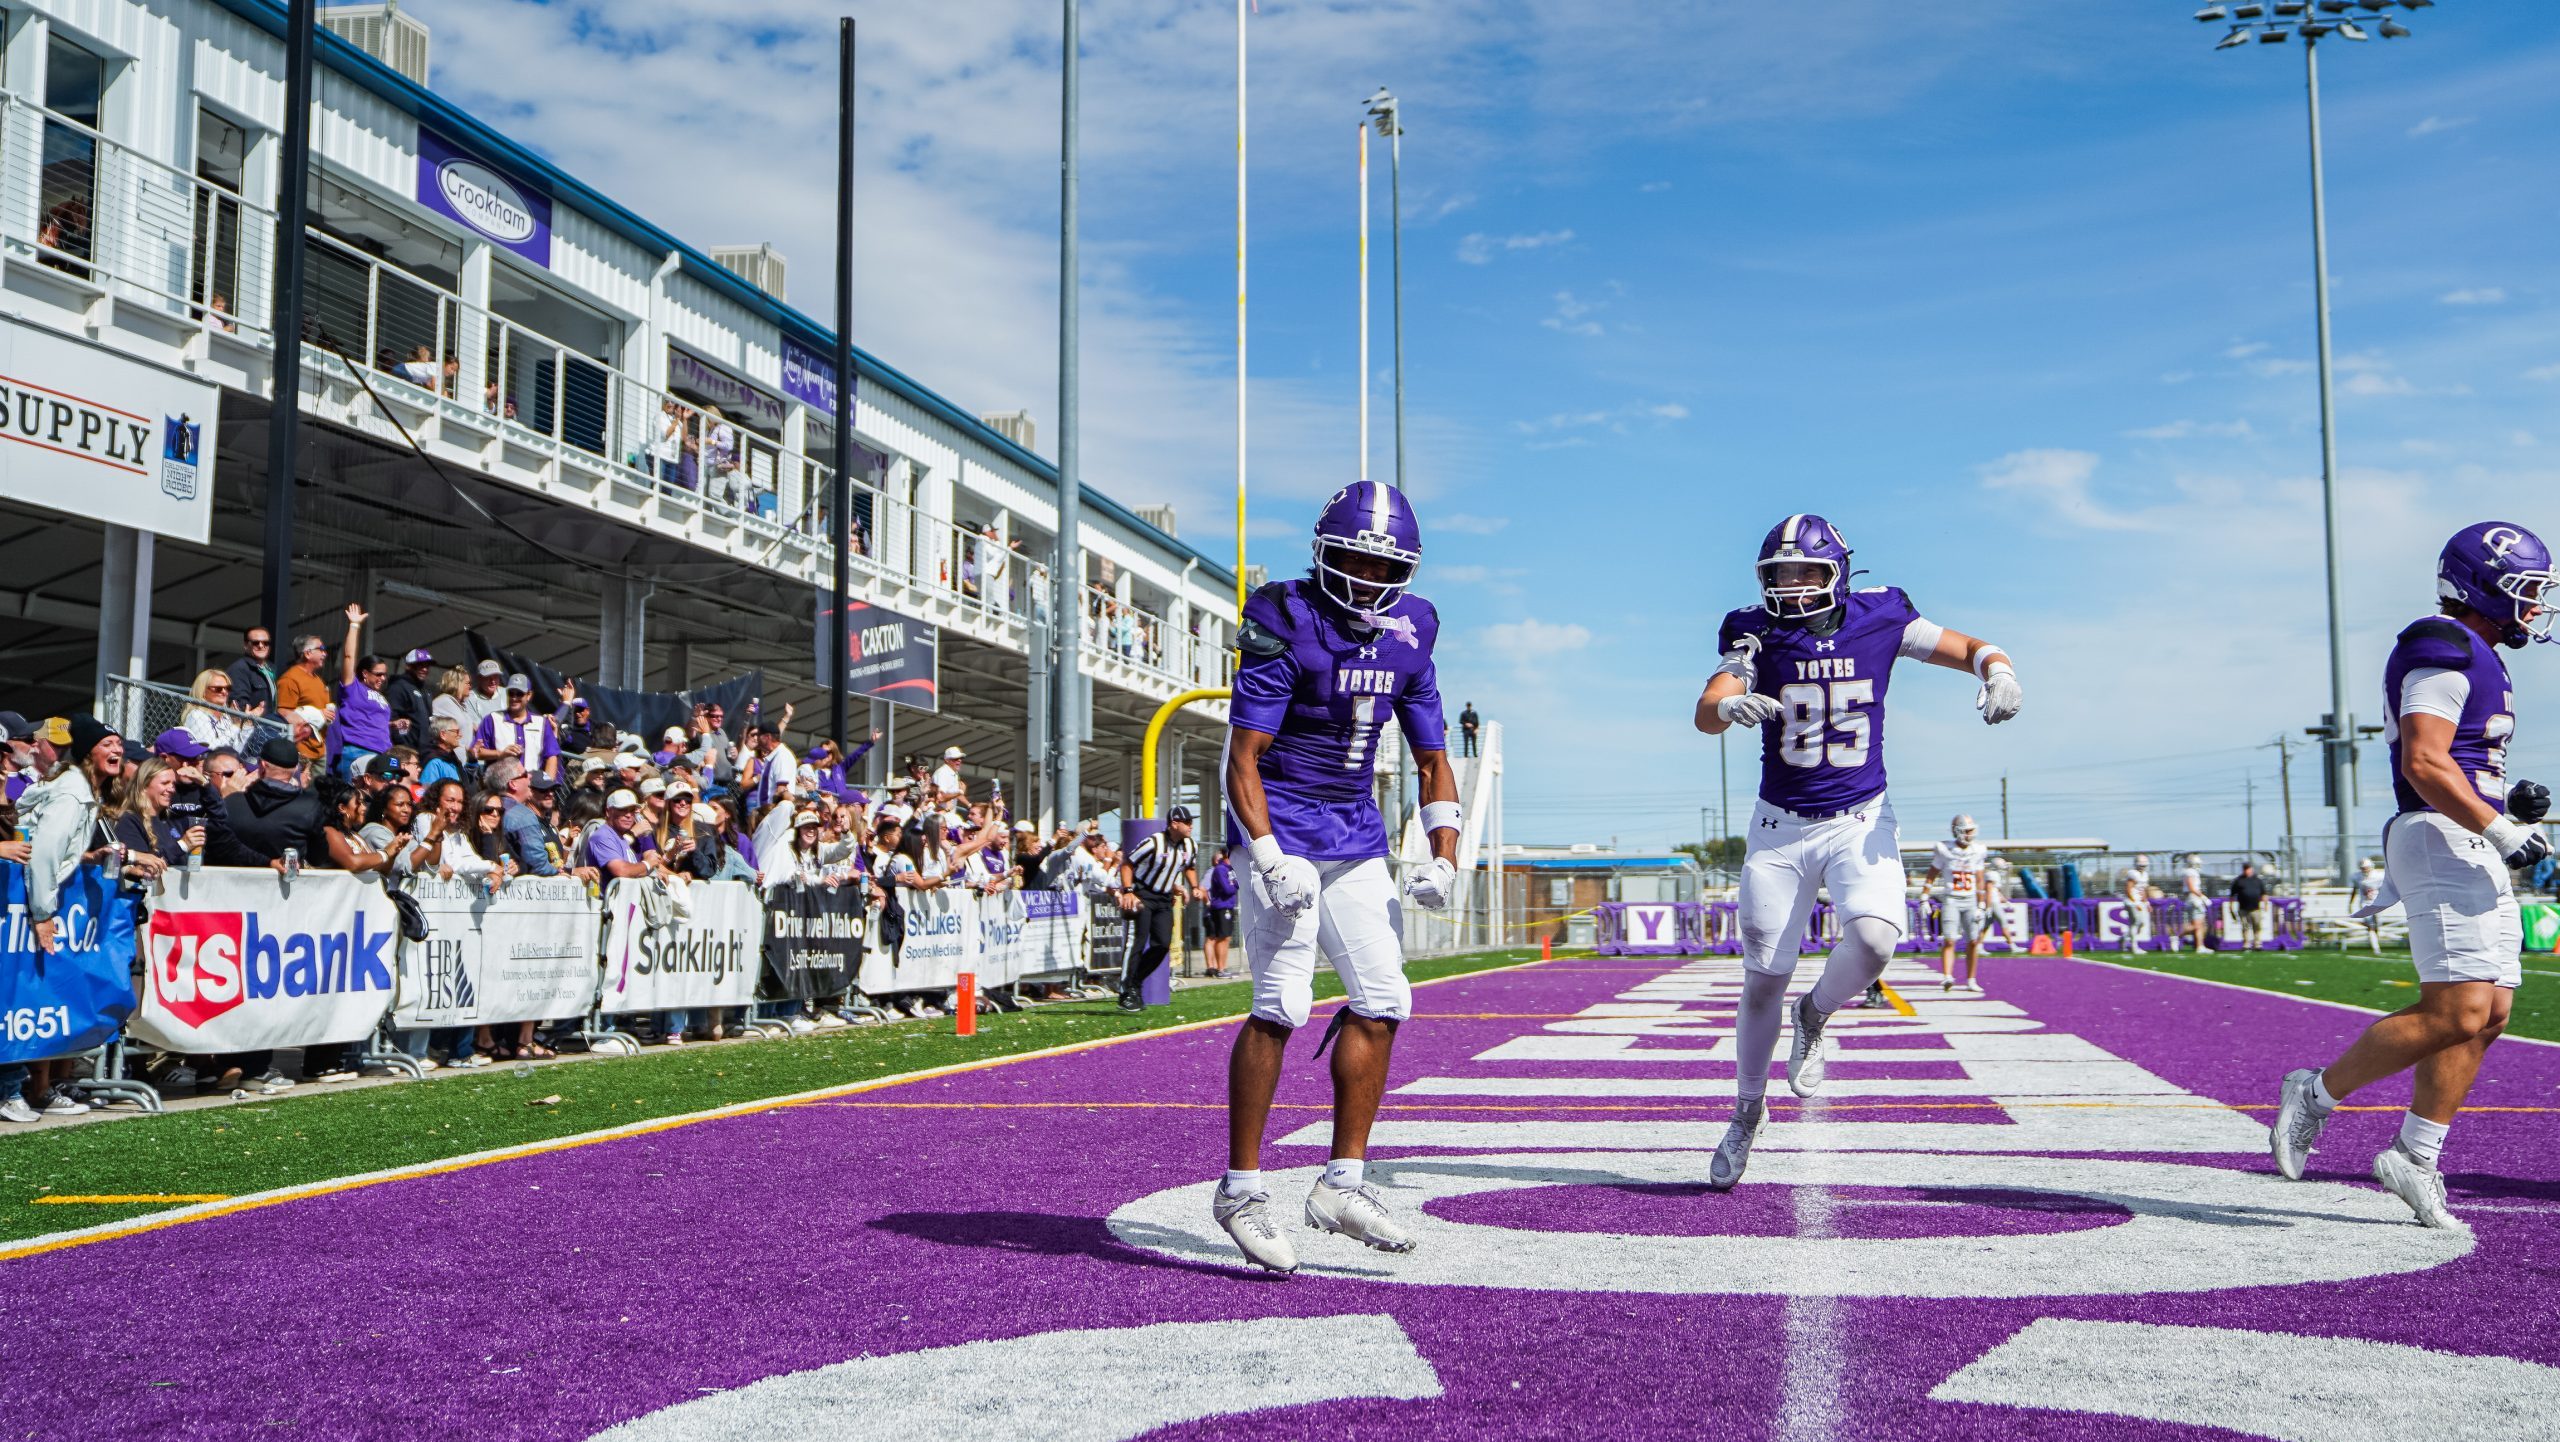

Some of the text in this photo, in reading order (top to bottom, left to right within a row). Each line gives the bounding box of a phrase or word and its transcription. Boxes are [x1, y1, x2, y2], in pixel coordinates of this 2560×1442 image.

[446, 168, 524, 232] Crookham
[164, 461, 194, 475] CALDWELL
[166, 468, 192, 484] NIGHT
[165, 479, 192, 494] RODEO
[861, 622, 904, 657] CAXTON
[1338, 669, 1395, 693] YOTES
[1795, 658, 1855, 681] YOTES
[1343, 696, 1376, 771] 1
[1779, 679, 1874, 768] 85
[1637, 910, 1667, 940] Y
[634, 928, 743, 985] Sparklight
[906, 945, 931, 961] Sports
